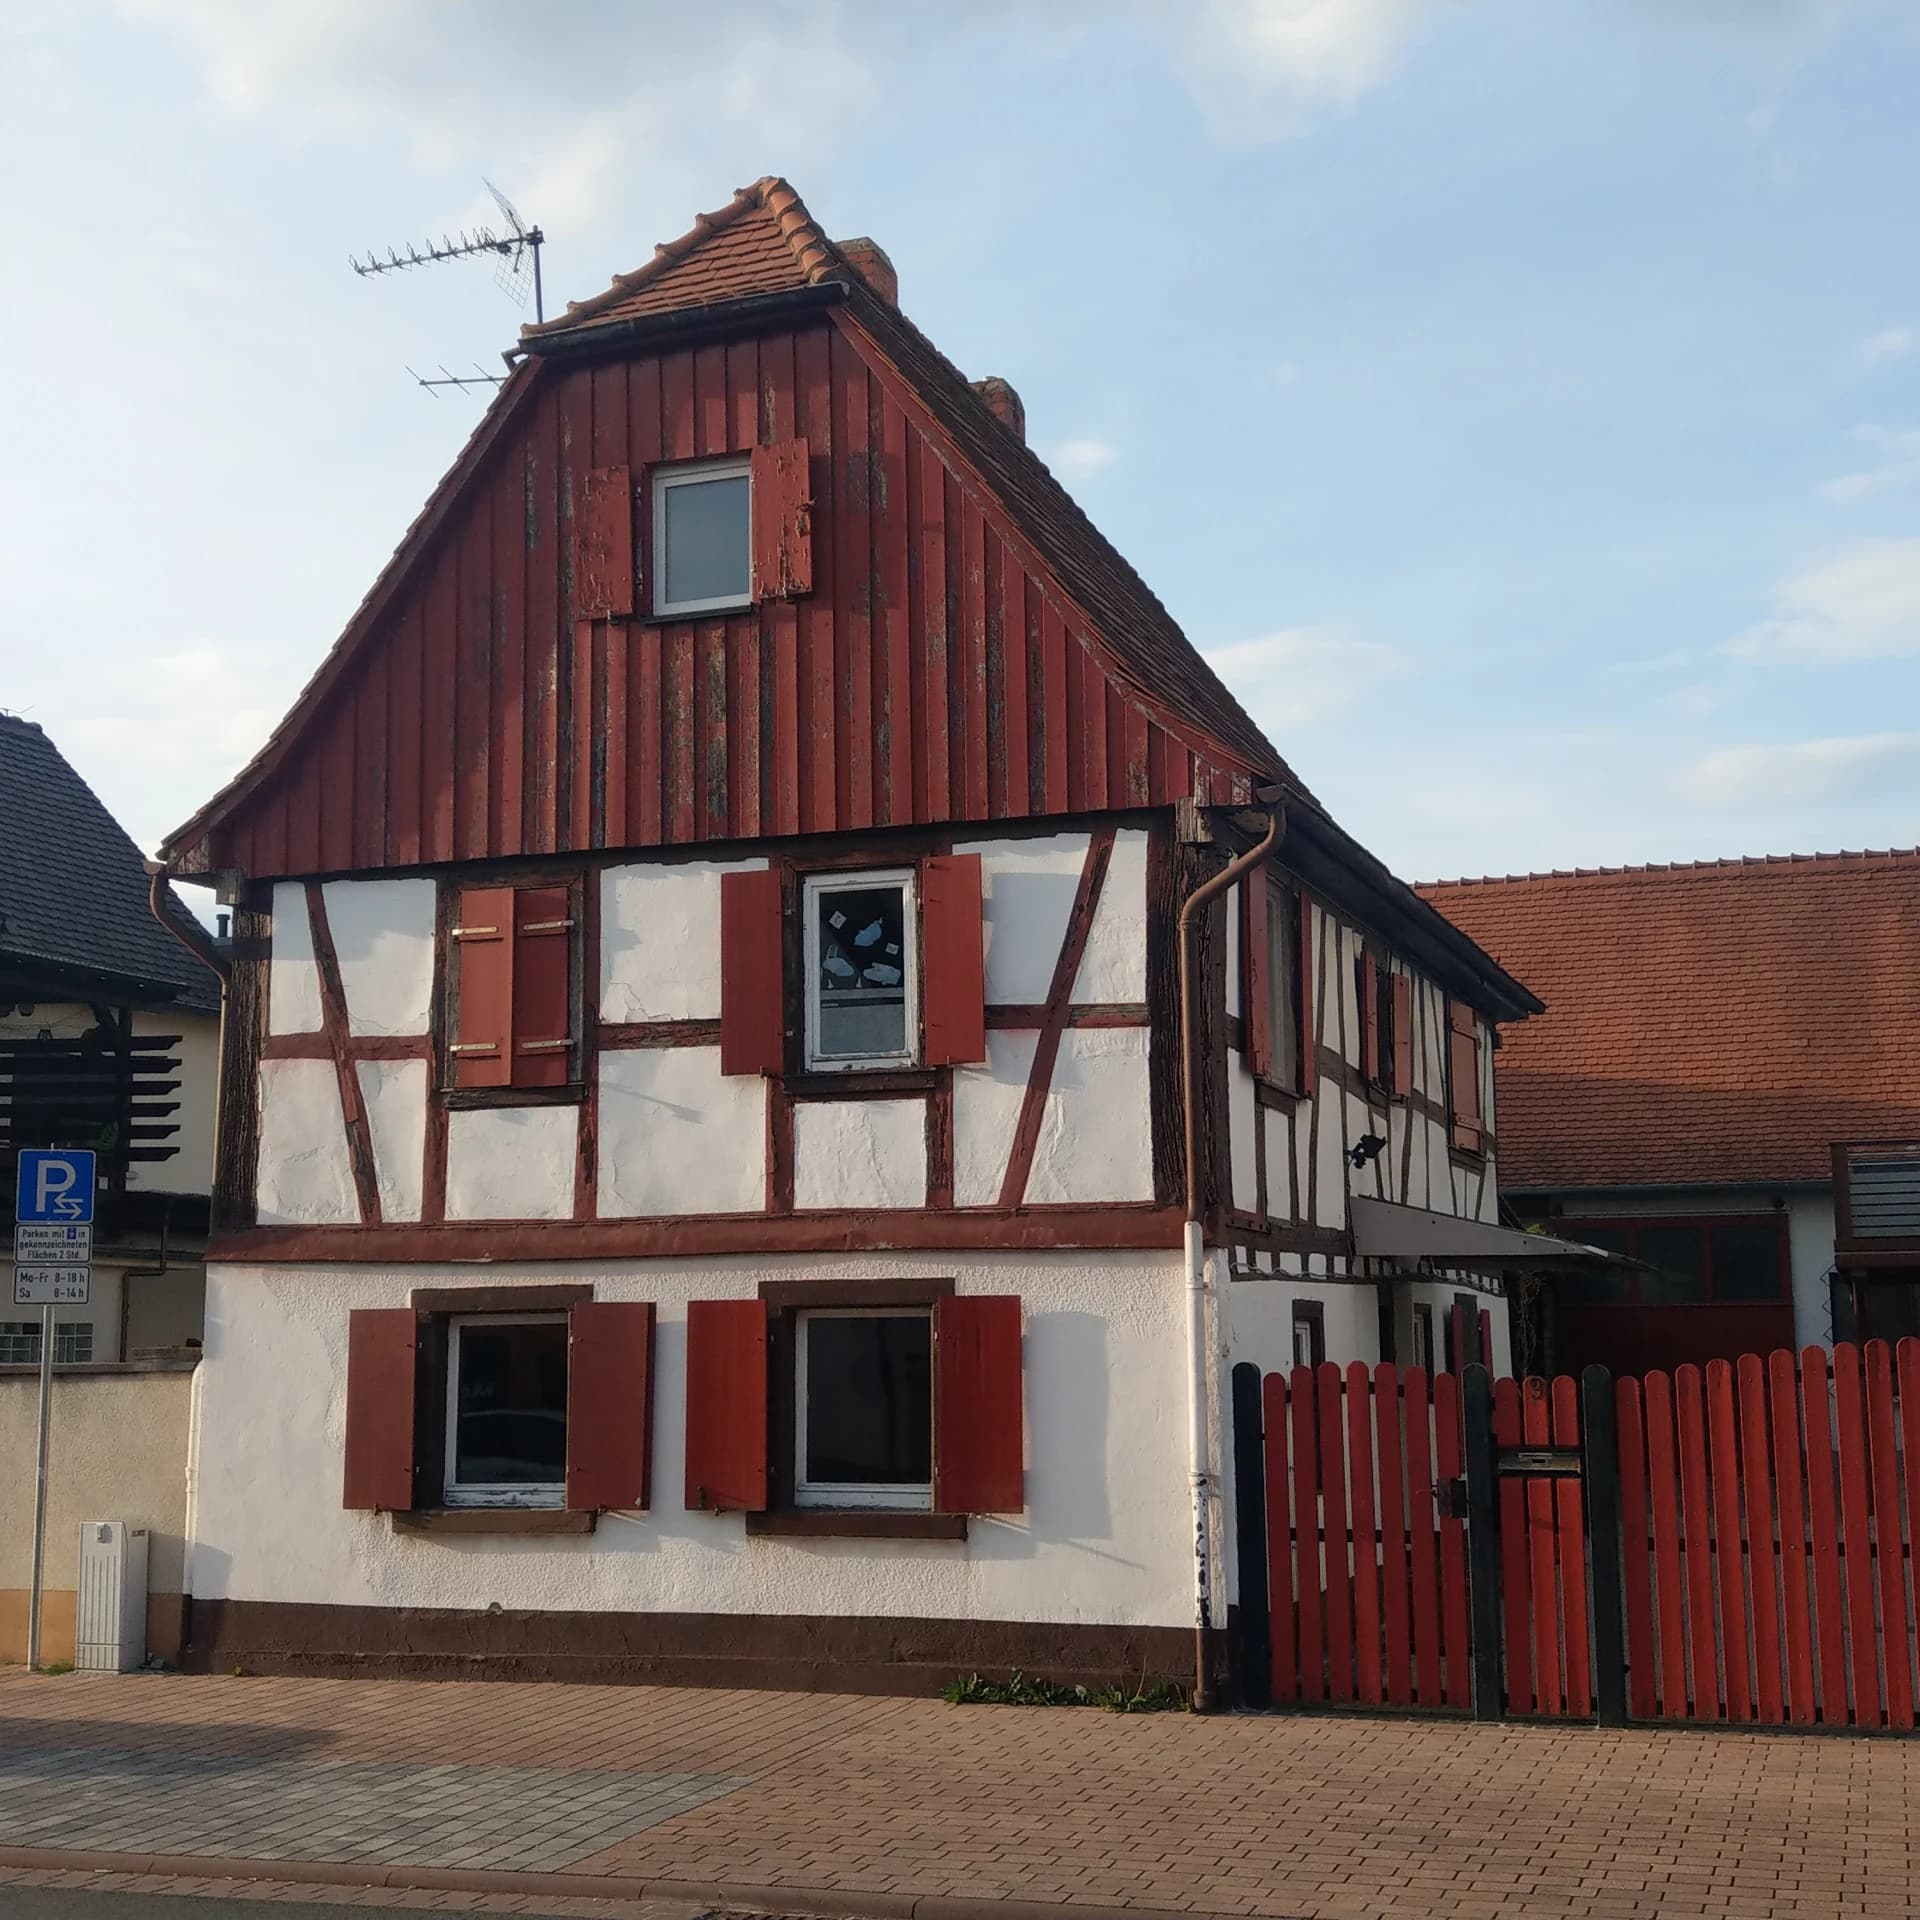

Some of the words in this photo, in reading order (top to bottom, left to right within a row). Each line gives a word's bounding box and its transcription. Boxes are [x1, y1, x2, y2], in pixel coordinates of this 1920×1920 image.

[36, 1160, 76, 1213] P
[22, 1229, 49, 1239] Parken
[52, 1230, 65, 1239] mit
[78, 1230, 86, 1239] in
[19, 1240, 88, 1250] gekennzeichneten
[27, 1250, 57, 1259] Flächen
[59, 1250, 64, 1259] 2
[20, 1272, 49, 1283] Mo-Fr
[79, 1272, 85, 1283] h
[19, 1287, 31, 1298] Sa
[78, 1287, 84, 1298] h
